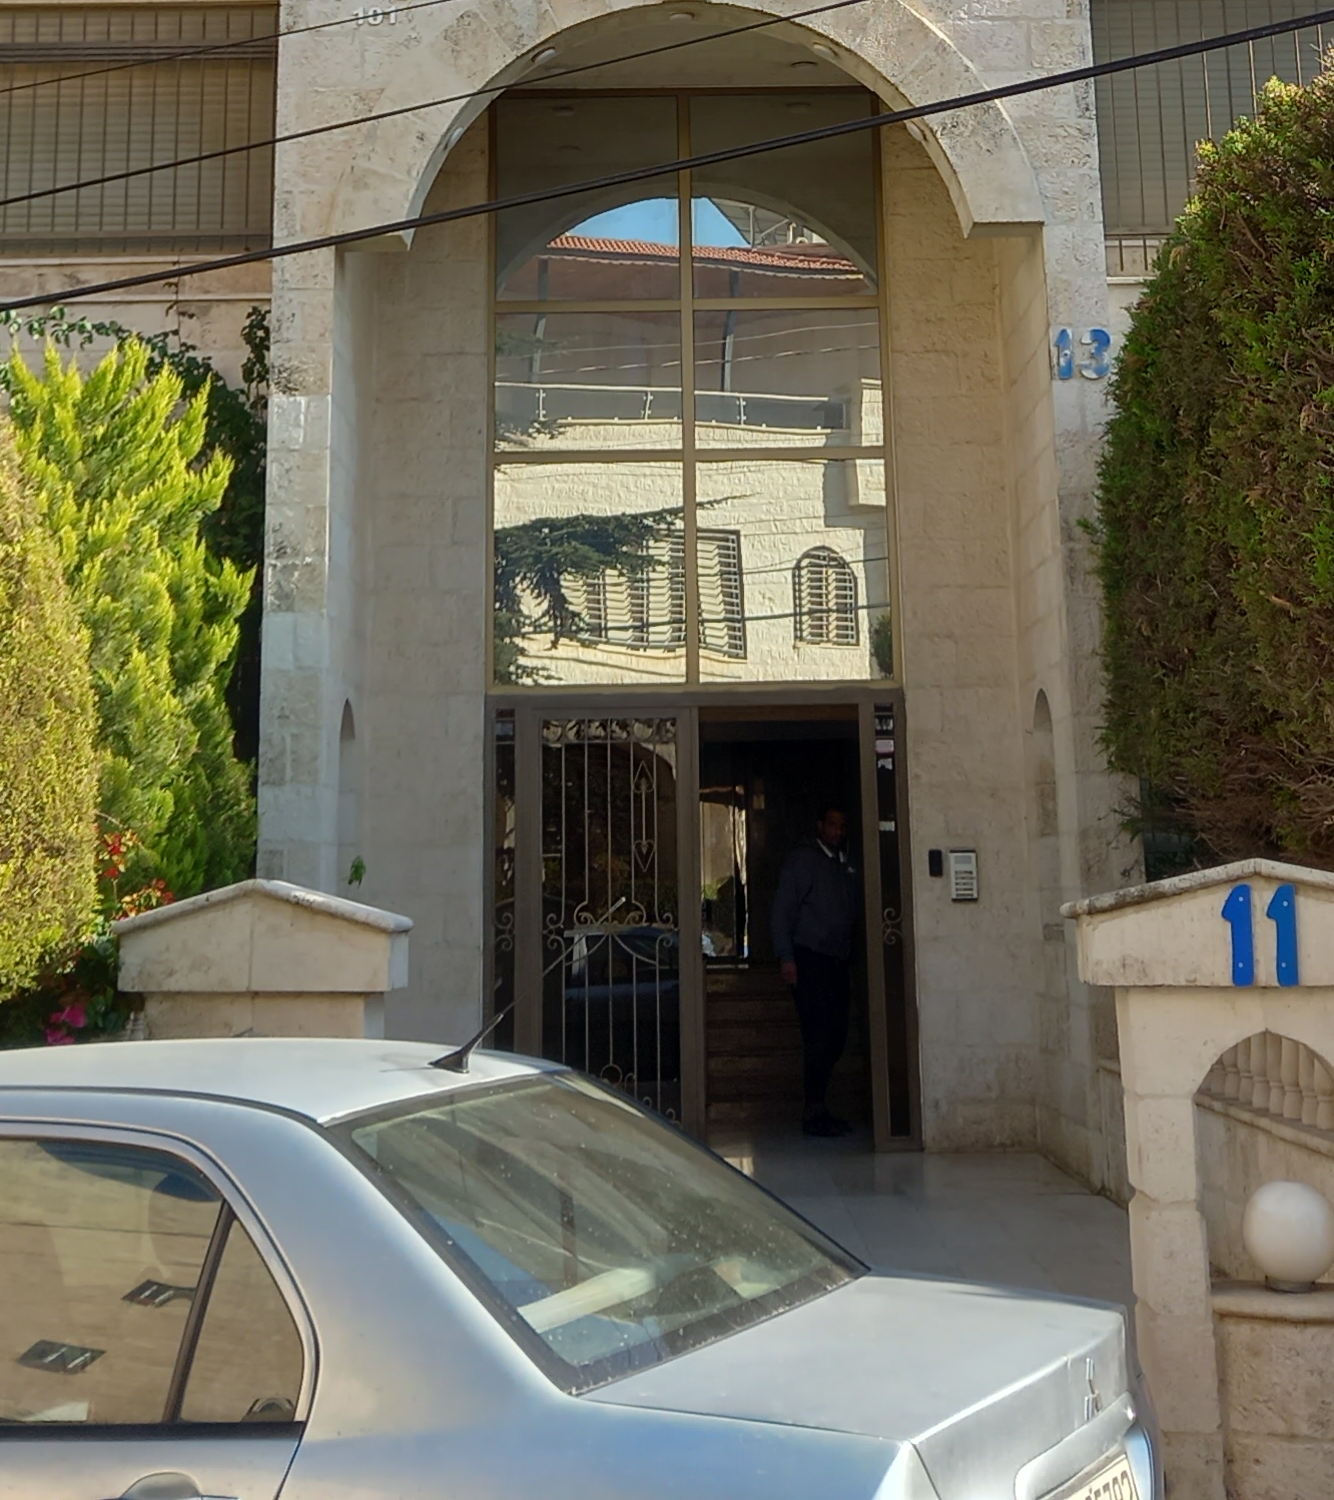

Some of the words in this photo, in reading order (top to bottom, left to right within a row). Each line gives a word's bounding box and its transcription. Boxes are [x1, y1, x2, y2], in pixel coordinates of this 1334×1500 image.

[352, 5, 398, 26] 101
[1054, 328, 1111, 380] 13
[1221, 883, 1300, 988] 11
